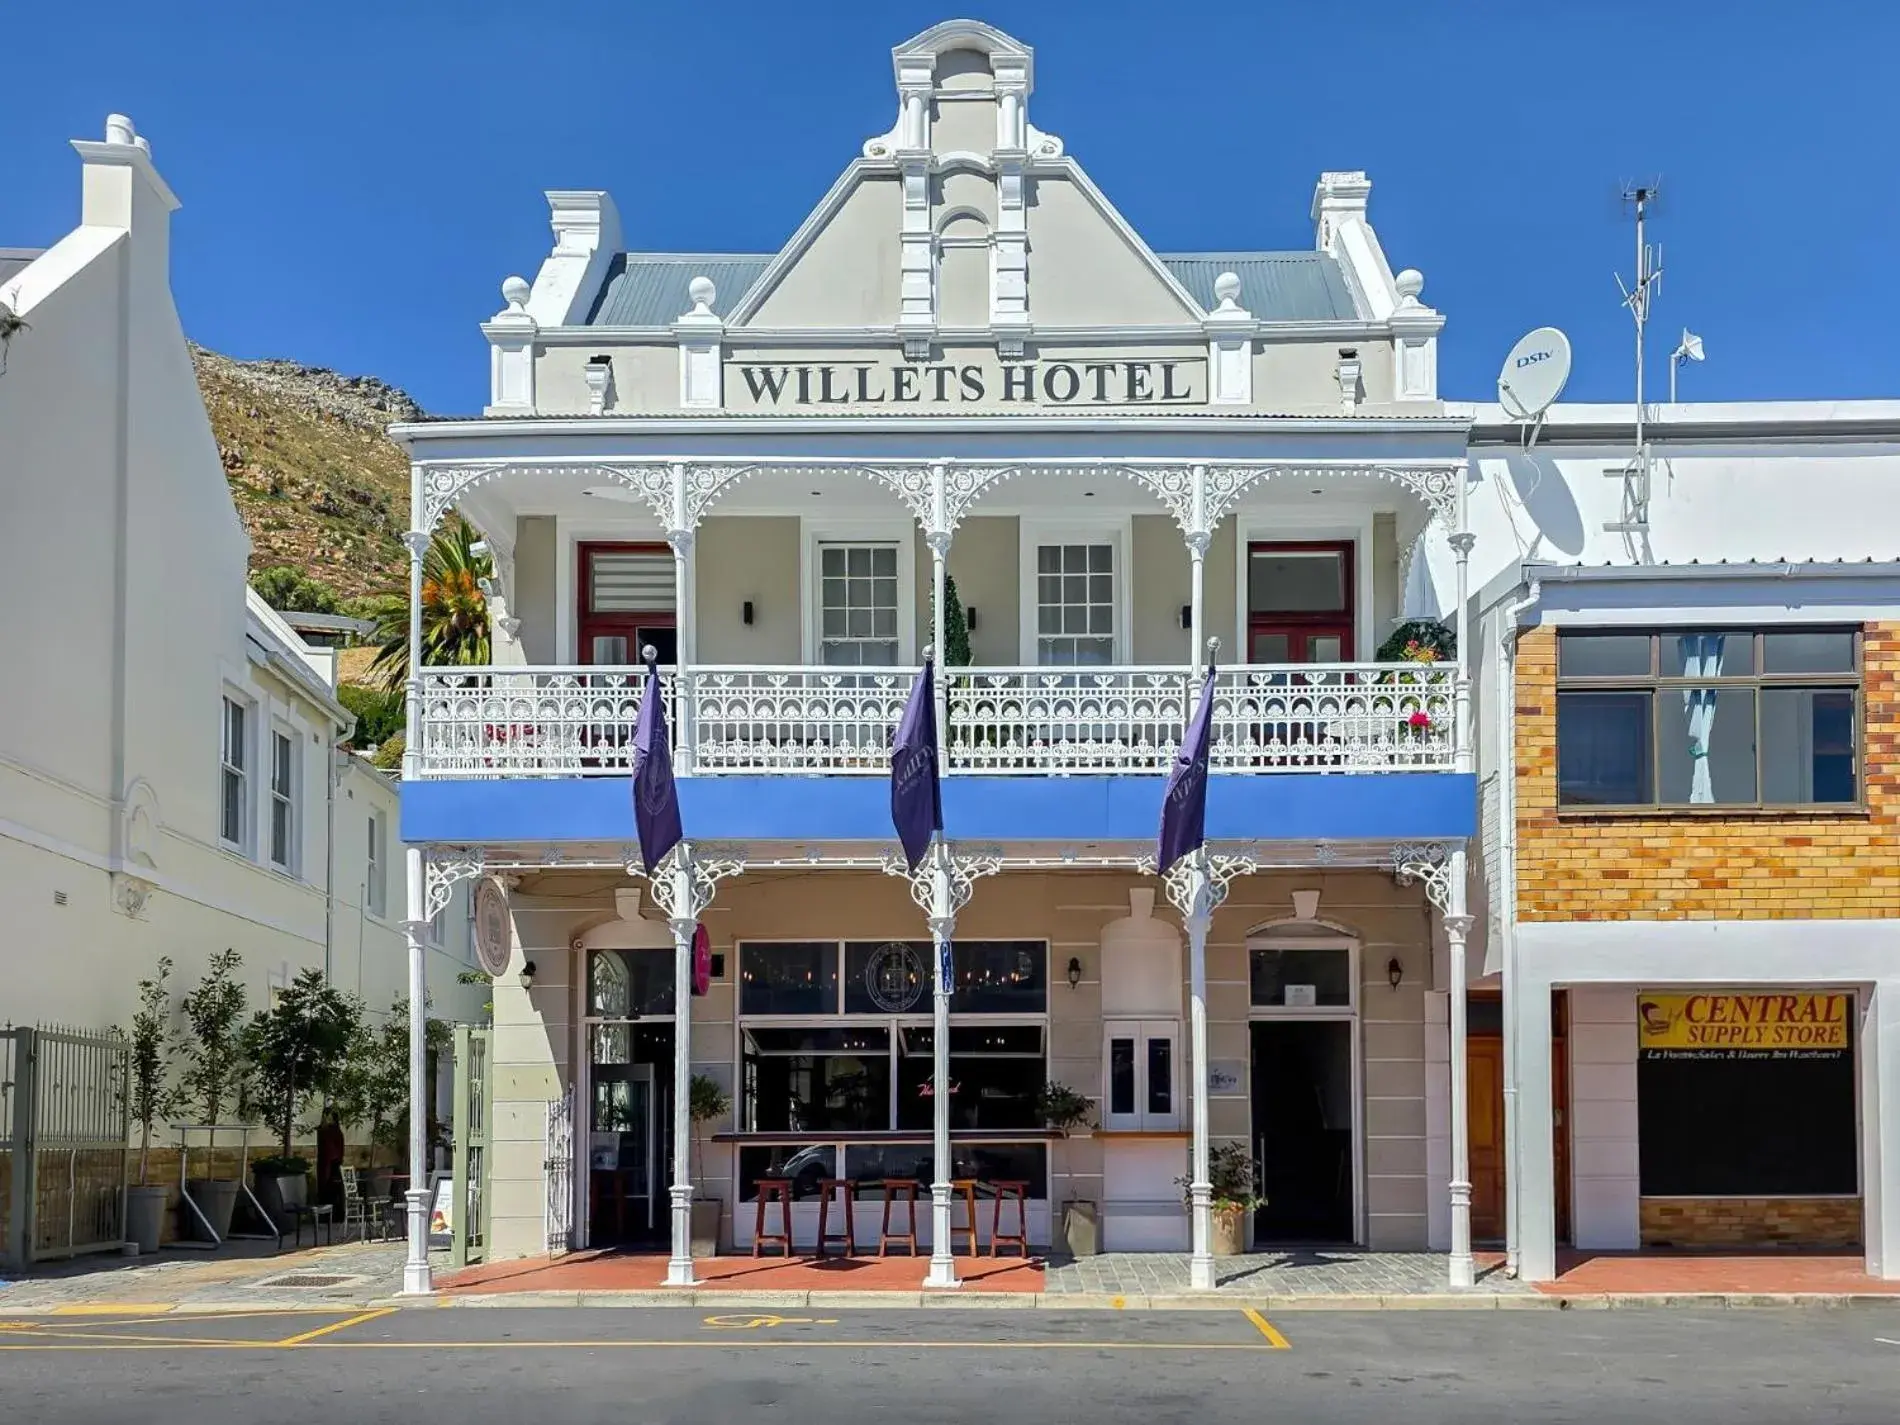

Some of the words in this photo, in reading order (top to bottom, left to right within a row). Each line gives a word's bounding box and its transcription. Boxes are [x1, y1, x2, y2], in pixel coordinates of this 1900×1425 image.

[742, 365, 985, 404] WILLETS
[1000, 363, 1191, 402] HOTEL
[1685, 995, 1842, 1023] CENTRAL
[1687, 1024, 1768, 1044] SUPPLY
[1772, 1025, 1842, 1043] STORE
